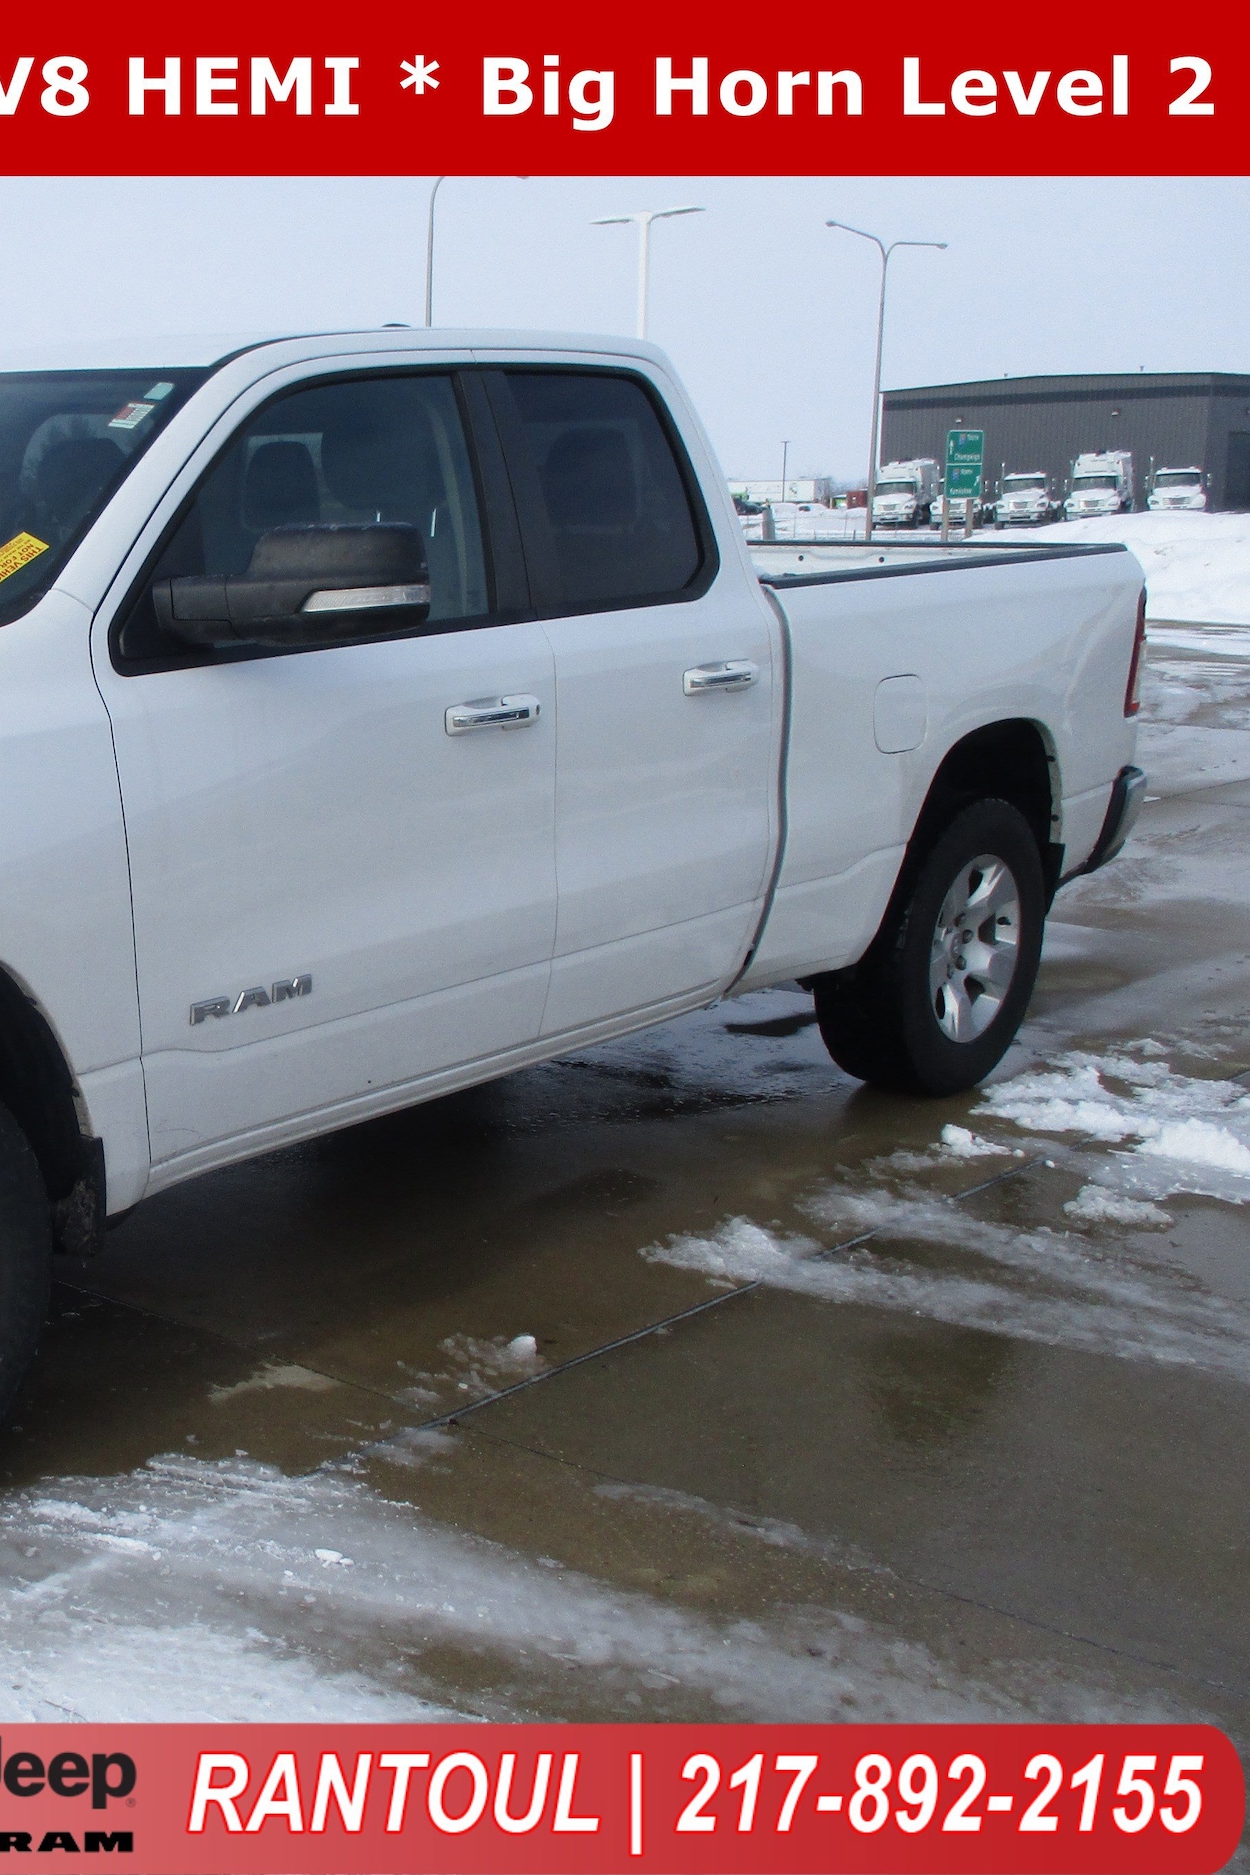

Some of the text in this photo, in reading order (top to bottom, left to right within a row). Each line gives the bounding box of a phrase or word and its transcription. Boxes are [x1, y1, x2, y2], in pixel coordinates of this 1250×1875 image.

[17, 543, 34, 556] NOT
[19, 546, 44, 562] THIS
[0, 555, 17, 568] FOR
[189, 973, 313, 1026] RAM
